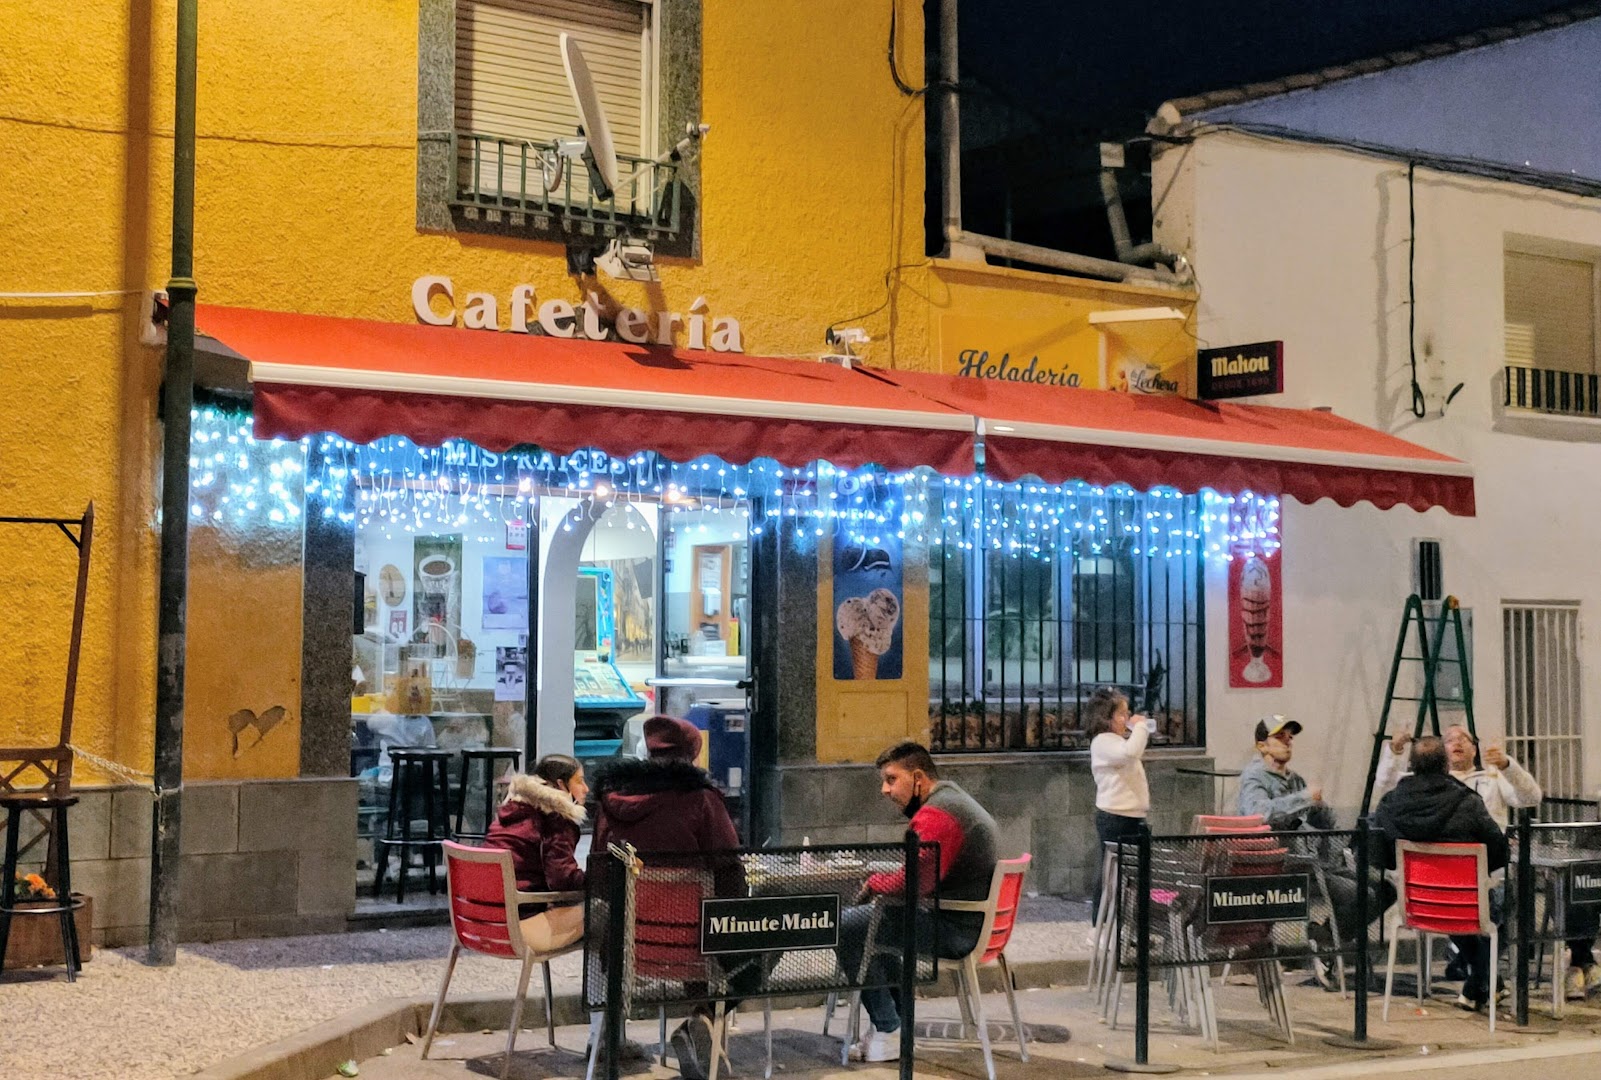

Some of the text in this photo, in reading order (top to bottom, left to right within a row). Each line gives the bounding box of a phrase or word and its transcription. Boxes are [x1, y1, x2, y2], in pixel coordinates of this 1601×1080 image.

[411, 275, 744, 353] Cafetería
[958, 349, 1082, 388] Heladería
[1211, 353, 1270, 377] Mahou
[1133, 369, 1179, 394] Lechera
[444, 442, 499, 468] MIS
[1213, 892, 1264, 907] Minute
[709, 916, 780, 935] Minute
